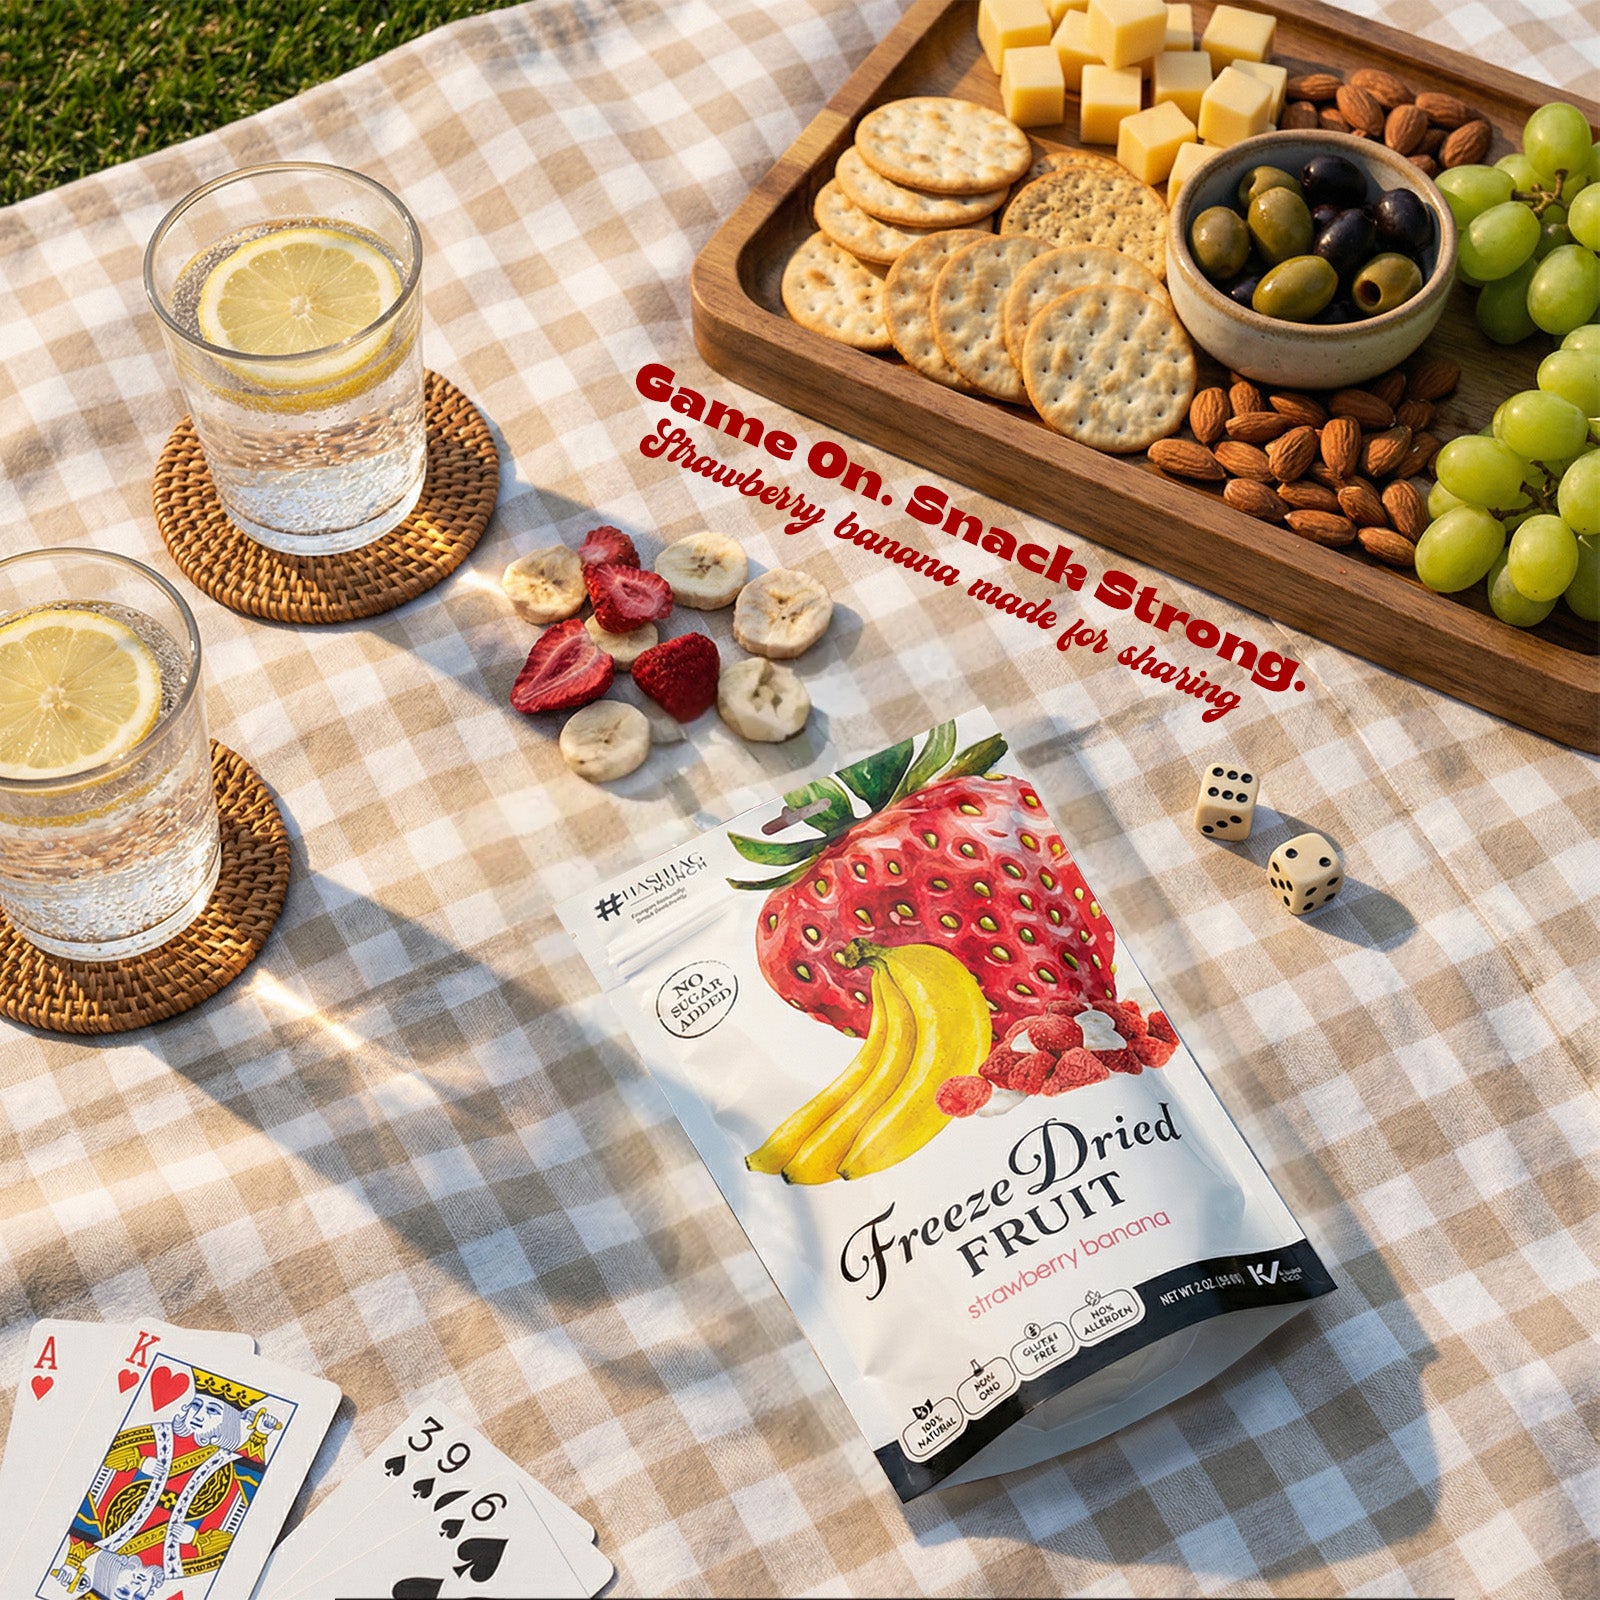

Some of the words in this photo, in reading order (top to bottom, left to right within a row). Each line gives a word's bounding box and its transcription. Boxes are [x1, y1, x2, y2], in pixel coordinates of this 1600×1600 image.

[670, 978, 723, 1019] SUGAR
[671, 973, 704, 1000] NO
[680, 987, 732, 1032] ADDED
[840, 1178, 1014, 1301] Freeze
[1007, 1101, 1182, 1196] Dried
[955, 1170, 1126, 1278] FRUIT
[968, 1248, 1079, 1320] strawberry
[1079, 1209, 1171, 1257] banana
[1160, 1289, 1181, 1307] NET
[1179, 1284, 1196, 1299] WT
[1194, 1281, 1203, 1294] 2
[34, 1336, 58, 1370] A
[125, 1330, 161, 1368] K
[408, 1416, 444, 1452] 3
[437, 1442, 471, 1474] 9
[471, 1492, 508, 1522] 6
